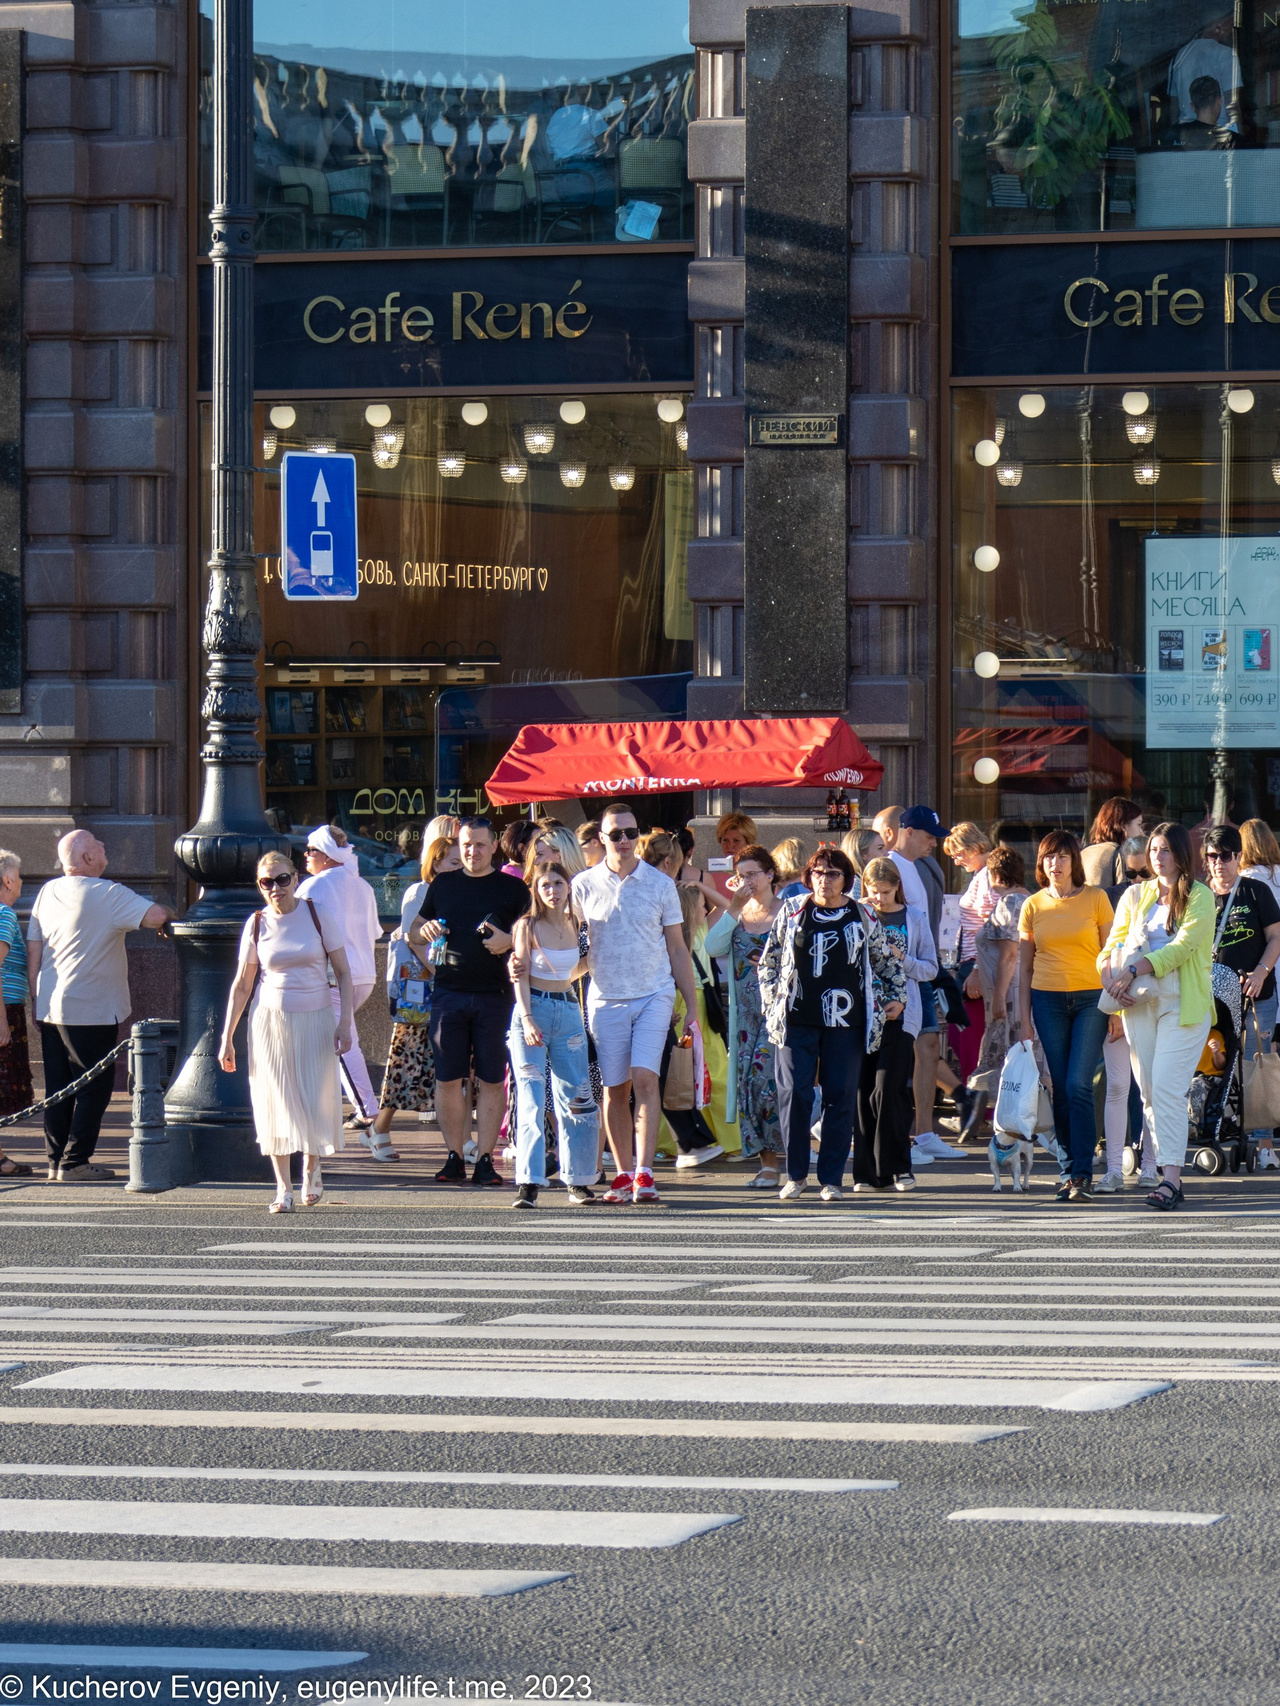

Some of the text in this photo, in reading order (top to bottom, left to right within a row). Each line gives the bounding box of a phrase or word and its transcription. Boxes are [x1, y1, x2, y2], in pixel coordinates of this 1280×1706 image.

[1064, 273, 1204, 328] Cafe
[303, 279, 594, 344] Cafe René
[758, 419, 831, 432] НЕВСКИЙ
[402, 560, 536, 591] САНКТ-ПЕТЕРБУРГ
[1151, 571, 1228, 591] КНИГИ
[1151, 596, 1247, 618] МЕСЯЦА
[1153, 693, 1178, 707] 390
[1195, 693, 1219, 707] 749
[1239, 692, 1264, 706] 699
[349, 788, 426, 815] ДОМ
